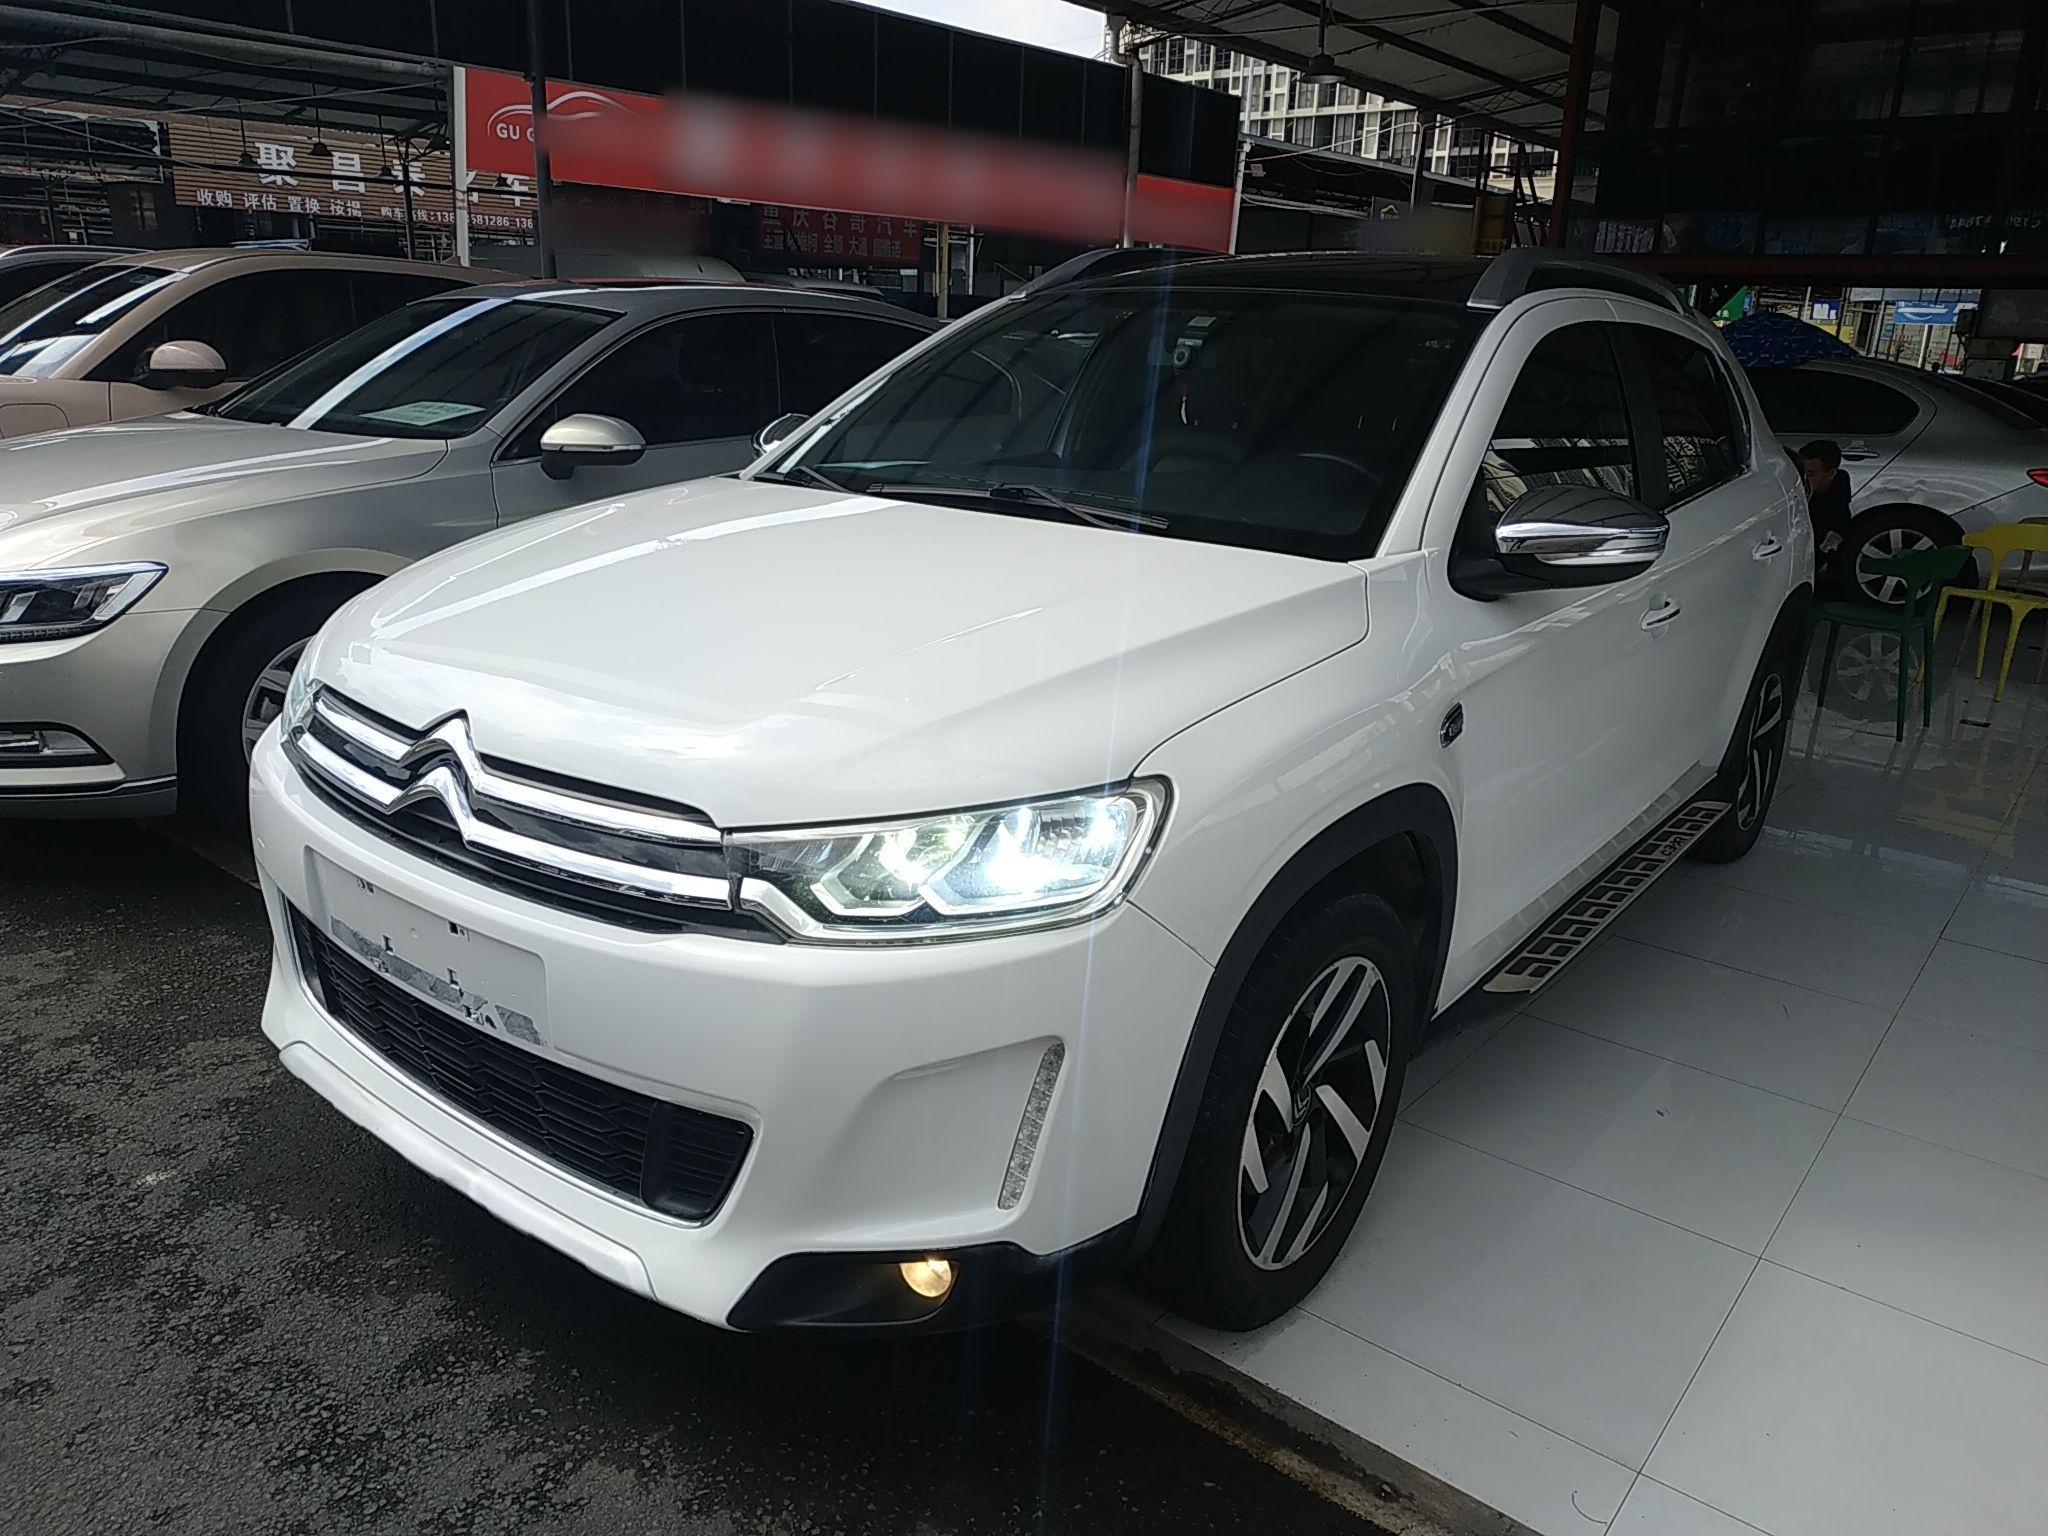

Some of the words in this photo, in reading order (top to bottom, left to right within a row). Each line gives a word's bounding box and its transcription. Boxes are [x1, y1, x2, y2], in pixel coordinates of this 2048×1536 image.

[496, 122, 520, 140] GU
[196, 188, 232, 208] 收购
[242, 192, 277, 211] 评估
[288, 196, 320, 214] 置换
